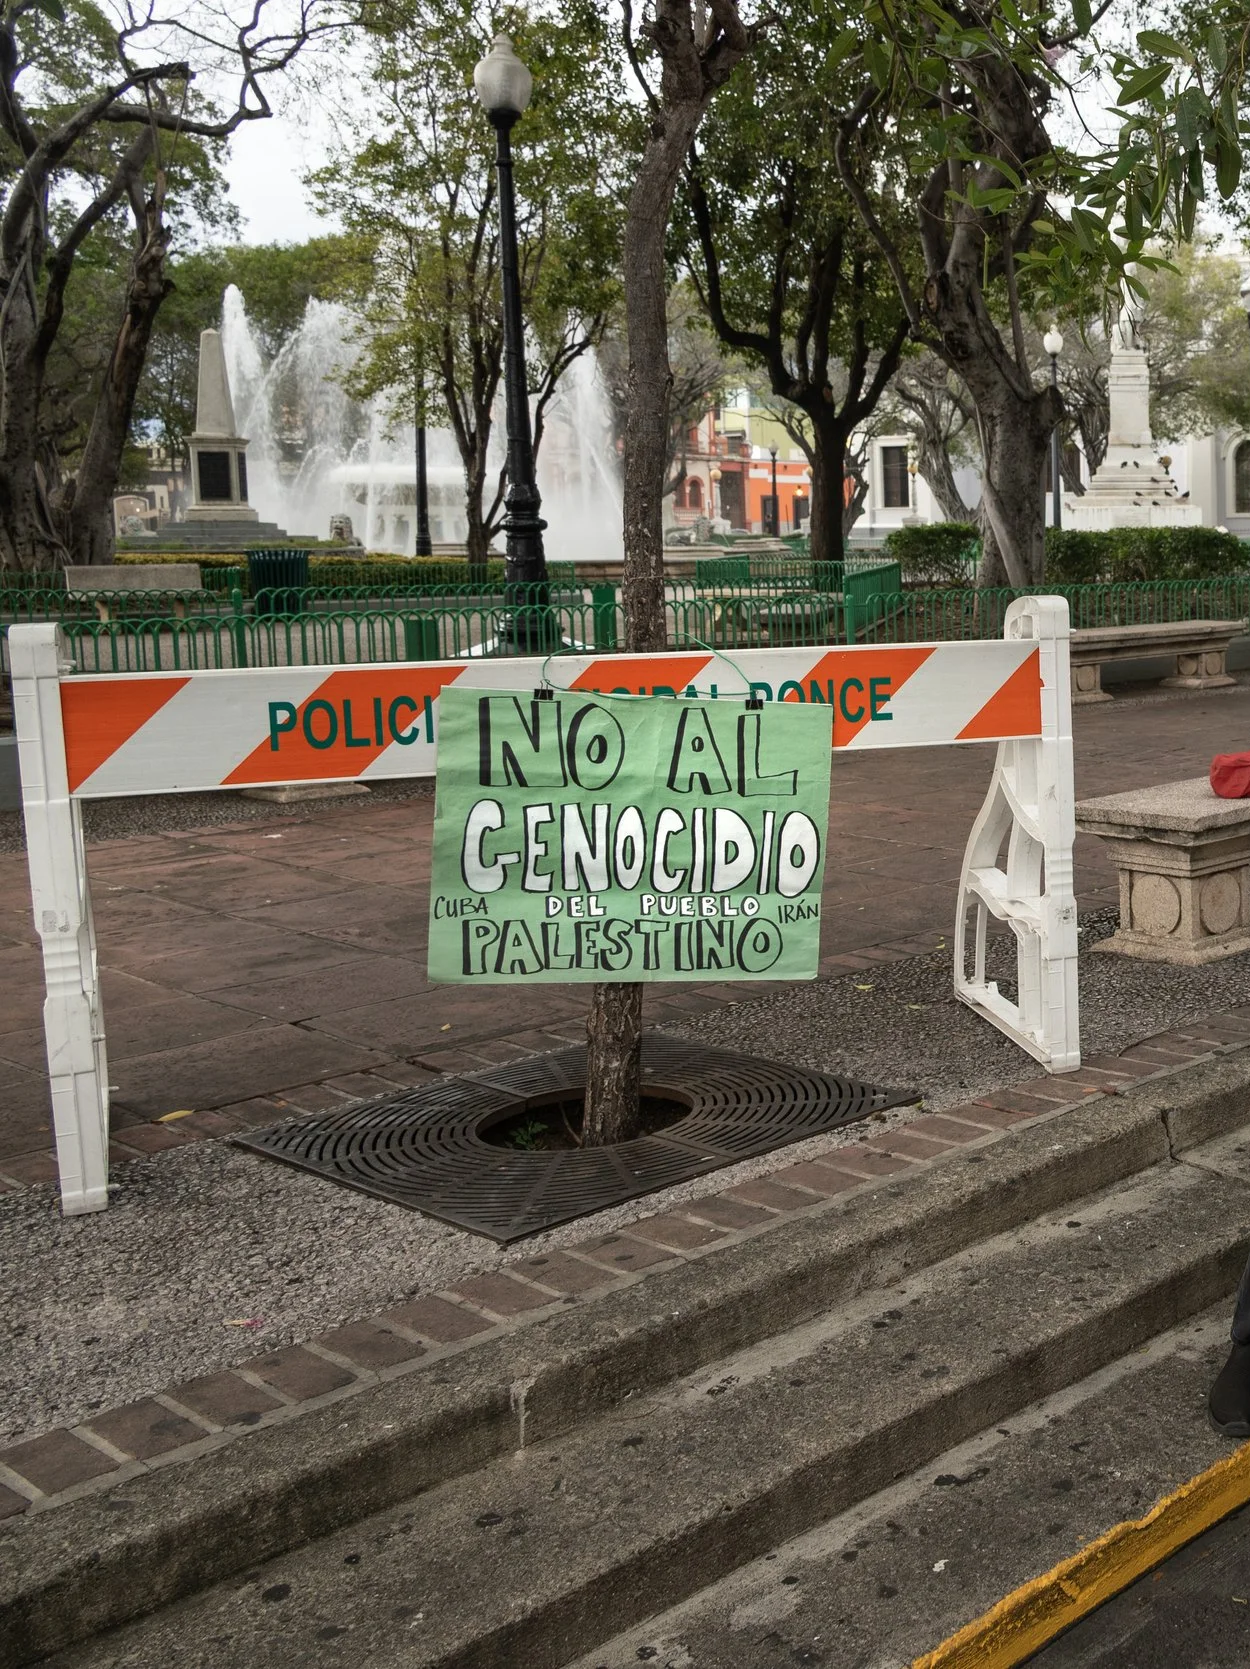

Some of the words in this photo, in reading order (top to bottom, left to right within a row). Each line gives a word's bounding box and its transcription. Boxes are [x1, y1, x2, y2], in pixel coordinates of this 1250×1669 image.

[268, 695, 435, 751] POLICI
[478, 696, 625, 791] NO
[667, 707, 798, 797] AL
[460, 798, 820, 898] GENOCIDIO
[433, 895, 489, 920] CUBA
[545, 895, 607, 917] DEL
[640, 895, 760, 917] PUEBLO
[777, 897, 819, 924] IRÁN
[461, 917, 783, 976] PALESTINO
